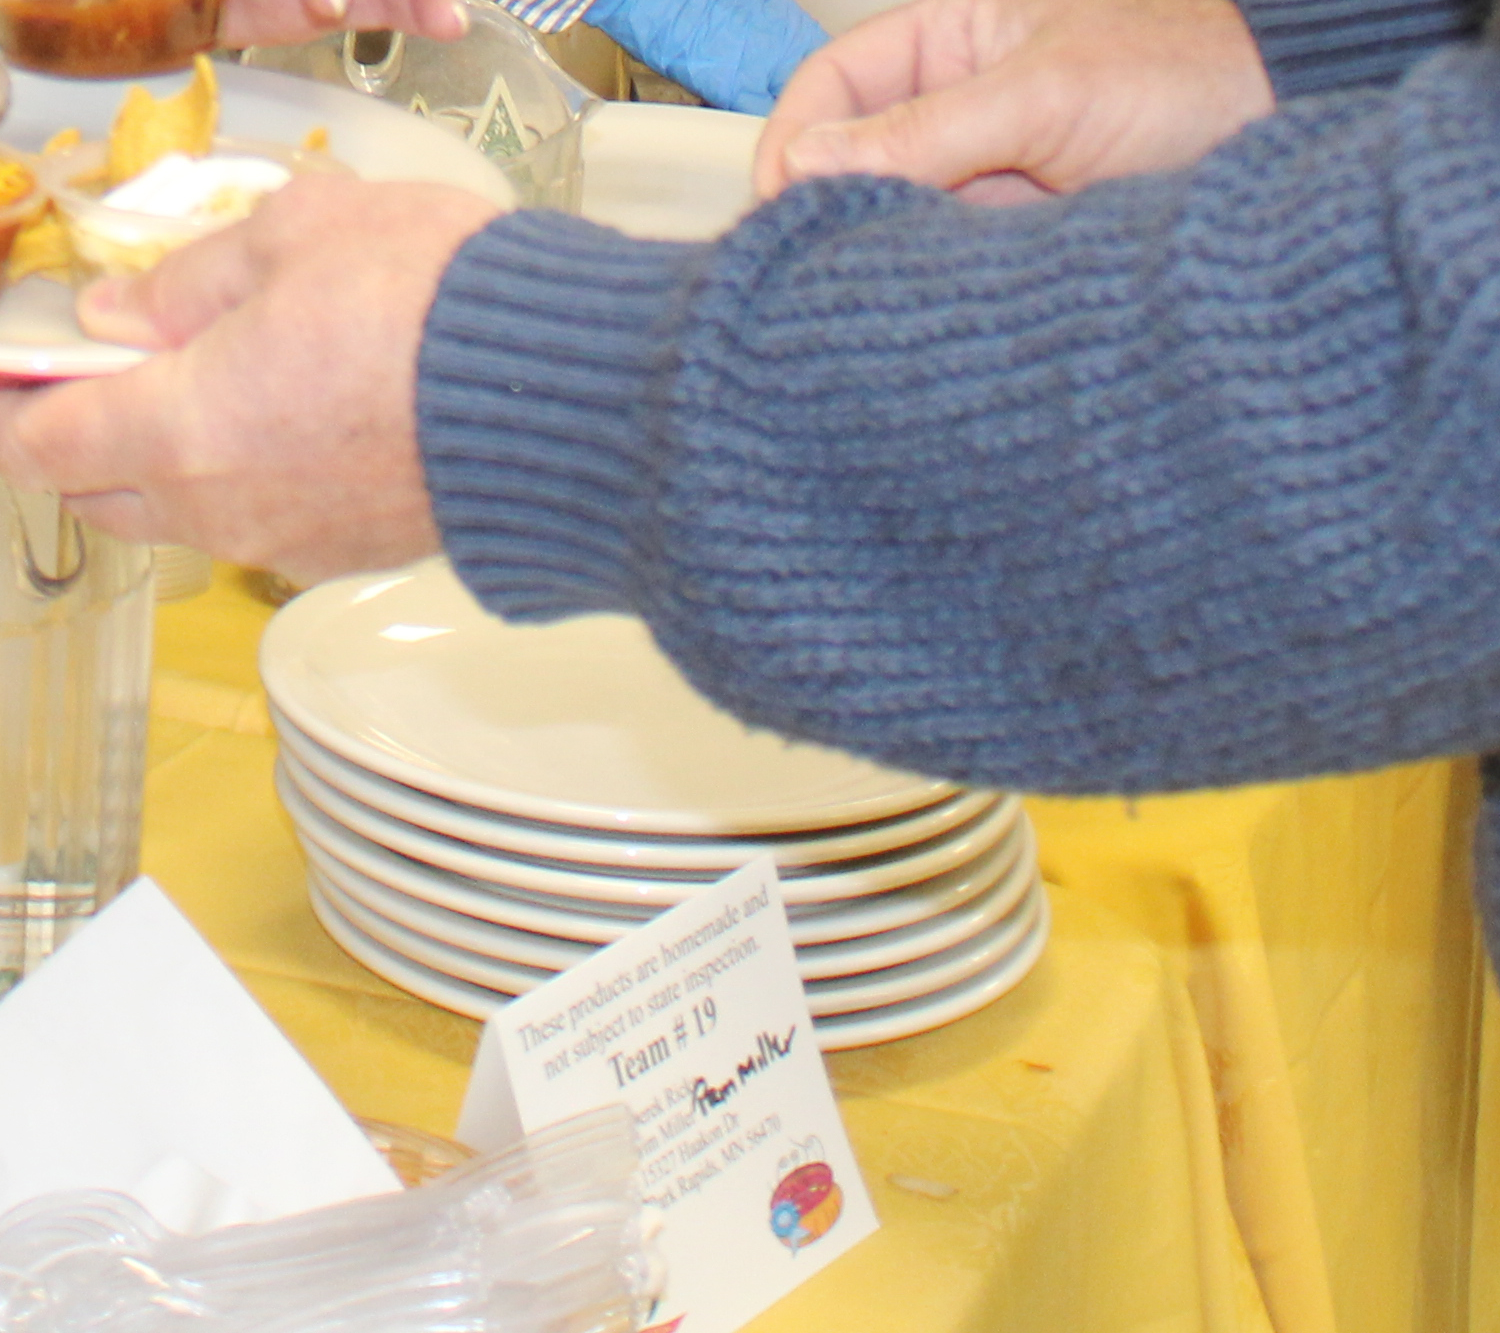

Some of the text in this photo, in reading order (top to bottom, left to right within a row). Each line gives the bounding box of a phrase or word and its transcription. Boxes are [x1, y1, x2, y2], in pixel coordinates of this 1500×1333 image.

[517, 884, 770, 1052] These products are homemade and
[543, 935, 762, 1080] not subject to state inspection.
[606, 995, 718, 1089] Team # 19
